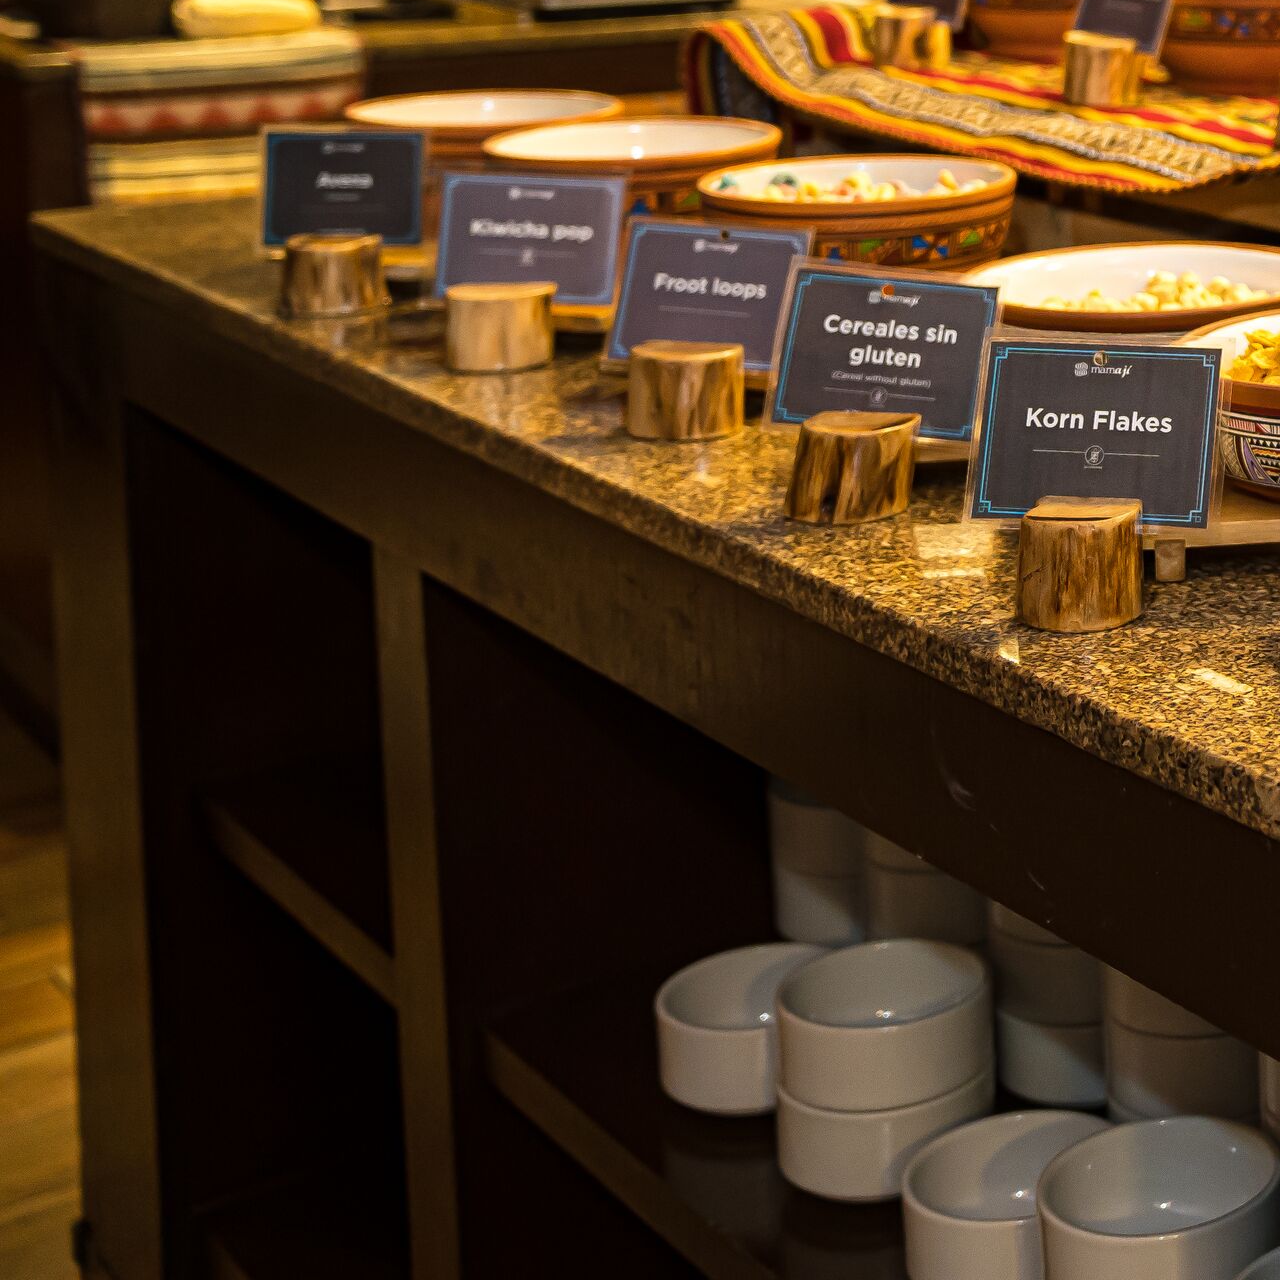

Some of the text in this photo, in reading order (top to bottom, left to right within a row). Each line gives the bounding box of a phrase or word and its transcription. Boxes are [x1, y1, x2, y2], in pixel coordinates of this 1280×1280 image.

[316, 172, 373, 189] Avena
[469, 219, 594, 243] Kiwicha pop
[653, 272, 768, 301] Froot loops
[823, 314, 959, 345] Cereales sin
[849, 344, 922, 369] gluten
[1025, 407, 1173, 434] Korn Flakes
